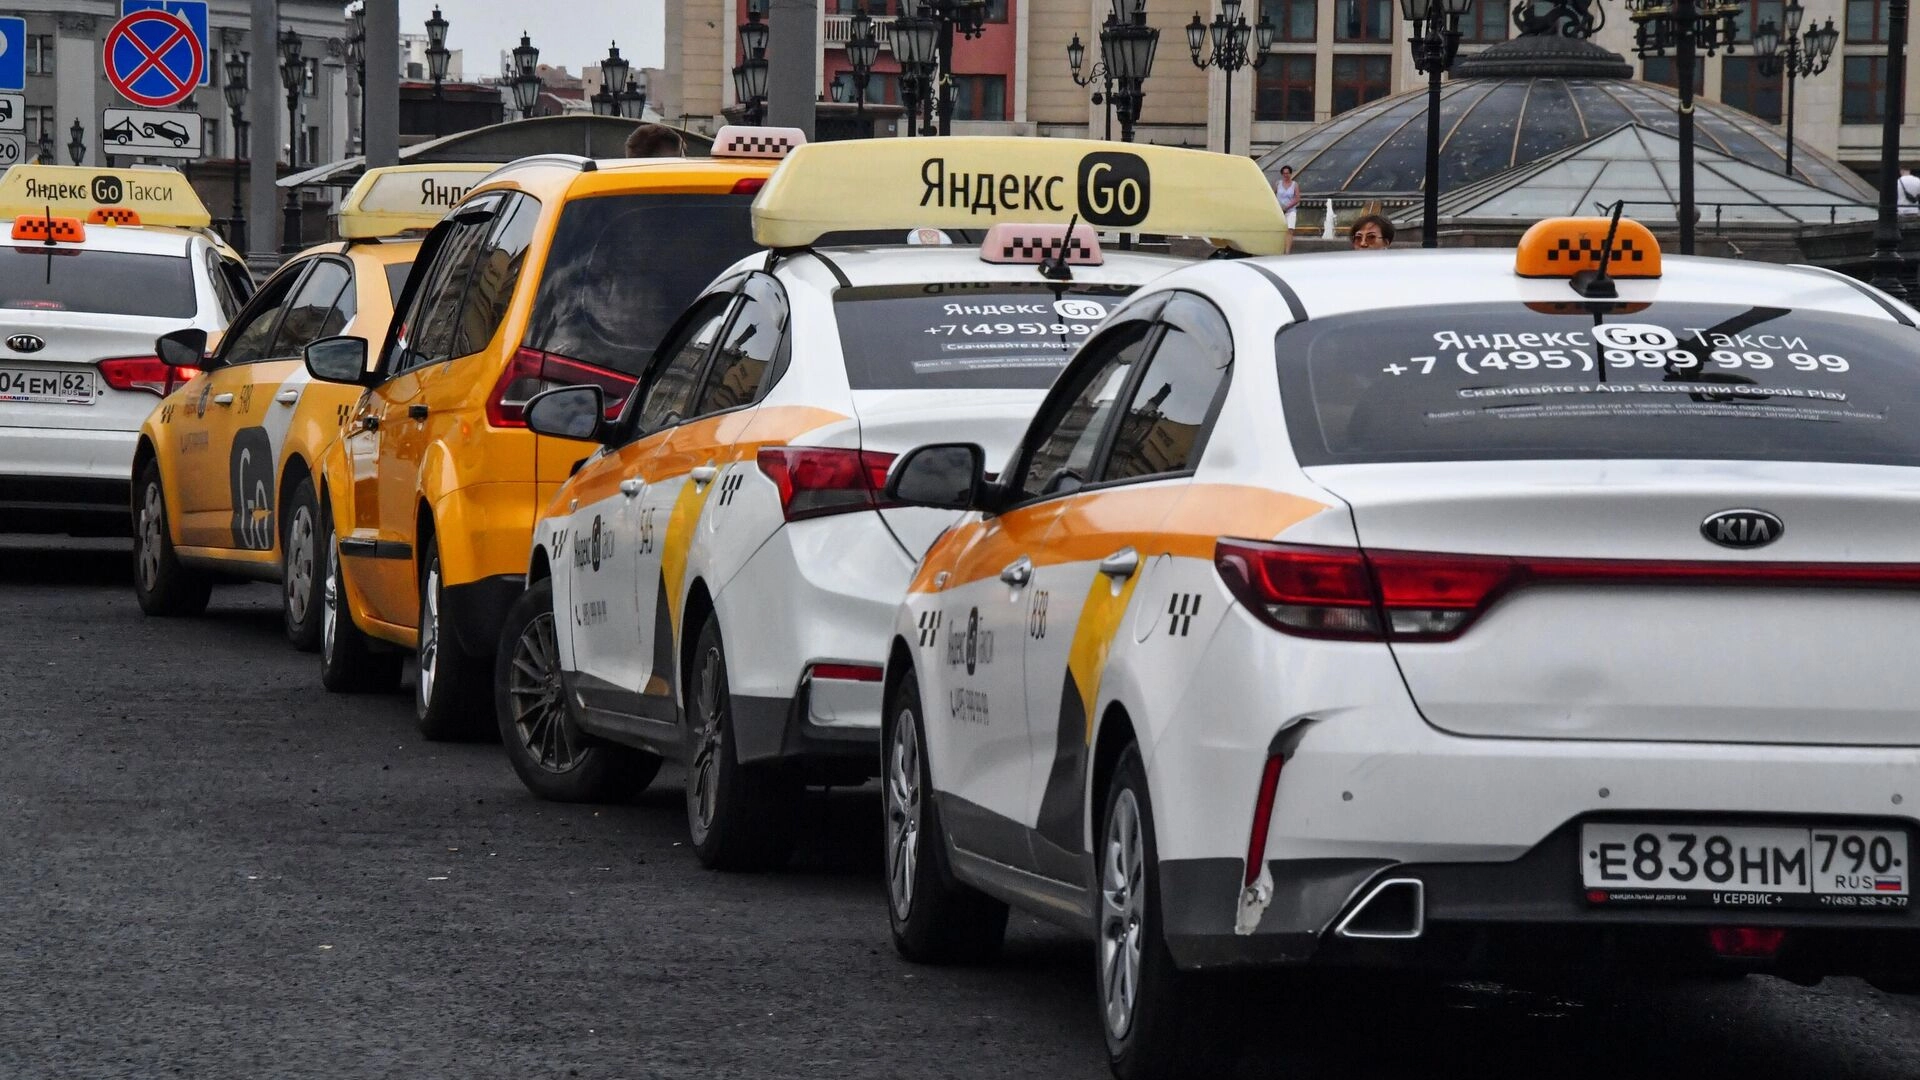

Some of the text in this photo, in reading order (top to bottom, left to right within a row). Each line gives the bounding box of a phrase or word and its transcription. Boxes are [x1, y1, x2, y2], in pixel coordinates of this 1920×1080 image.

[26, 178, 173, 201] Яндекс Go Такси
[919, 157, 1142, 216] Яндекс Go
[943, 302, 1099, 316] Яндекс Go
[12, 337, 39, 350] KIA
[947, 342, 1028, 351] Скачивайте
[1043, 342, 1071, 350] App
[1433, 327, 1808, 351] Яндекс Go Такси
[1383, 349, 1850, 376] +7 (495) 999 99 99
[63, 374, 85, 391] 62
[1460, 385, 1575, 398] Скачивайте
[1595, 384, 1635, 393] App
[1638, 384, 1690, 392] Store
[1694, 385, 1731, 394] или
[1735, 386, 1804, 396] Google
[1806, 388, 1846, 401] Play
[1717, 518, 1770, 541] KIA
[1031, 590, 1048, 639] 838
[1815, 835, 1893, 873] 790
[1835, 875, 1873, 889] RUS
[1713, 893, 1720, 904] У
[1724, 893, 1772, 905] СЕРВИС
